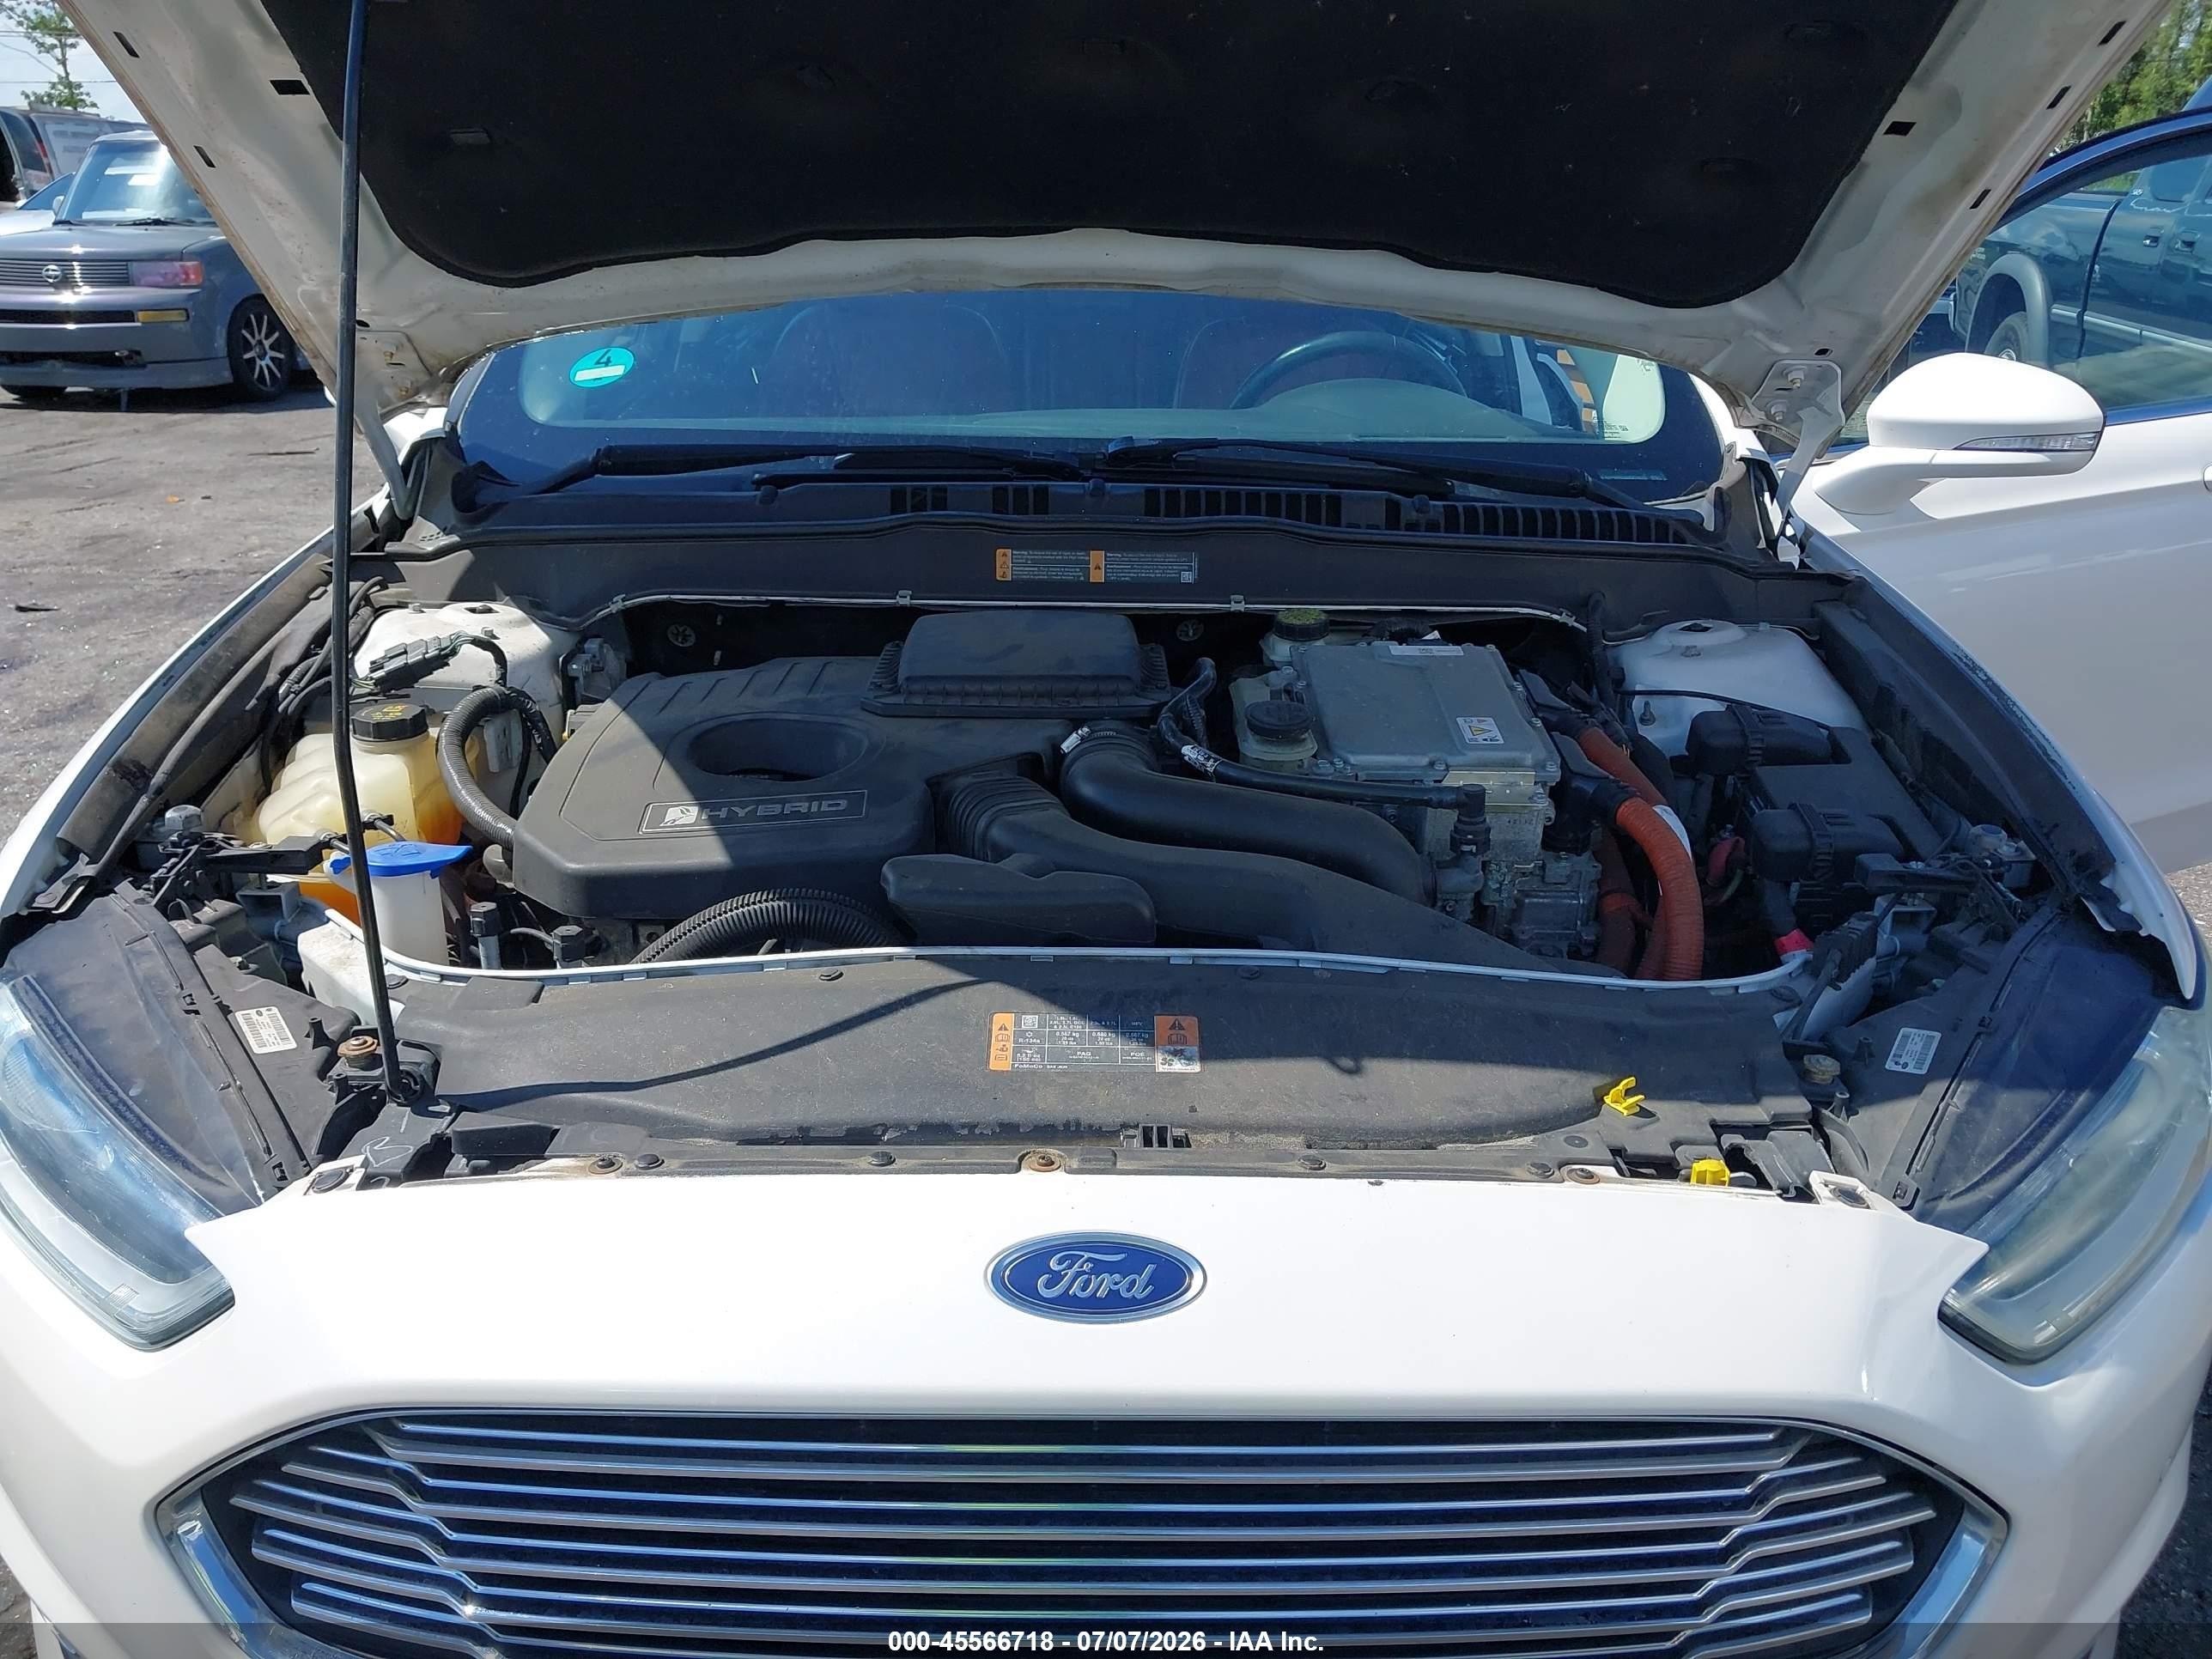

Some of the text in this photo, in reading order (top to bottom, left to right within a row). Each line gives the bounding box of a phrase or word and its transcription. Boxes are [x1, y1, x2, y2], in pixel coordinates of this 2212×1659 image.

[594, 349, 612, 367] 4
[701, 799, 848, 820] HYBRID
[1037, 1250, 1158, 1299] Ford
